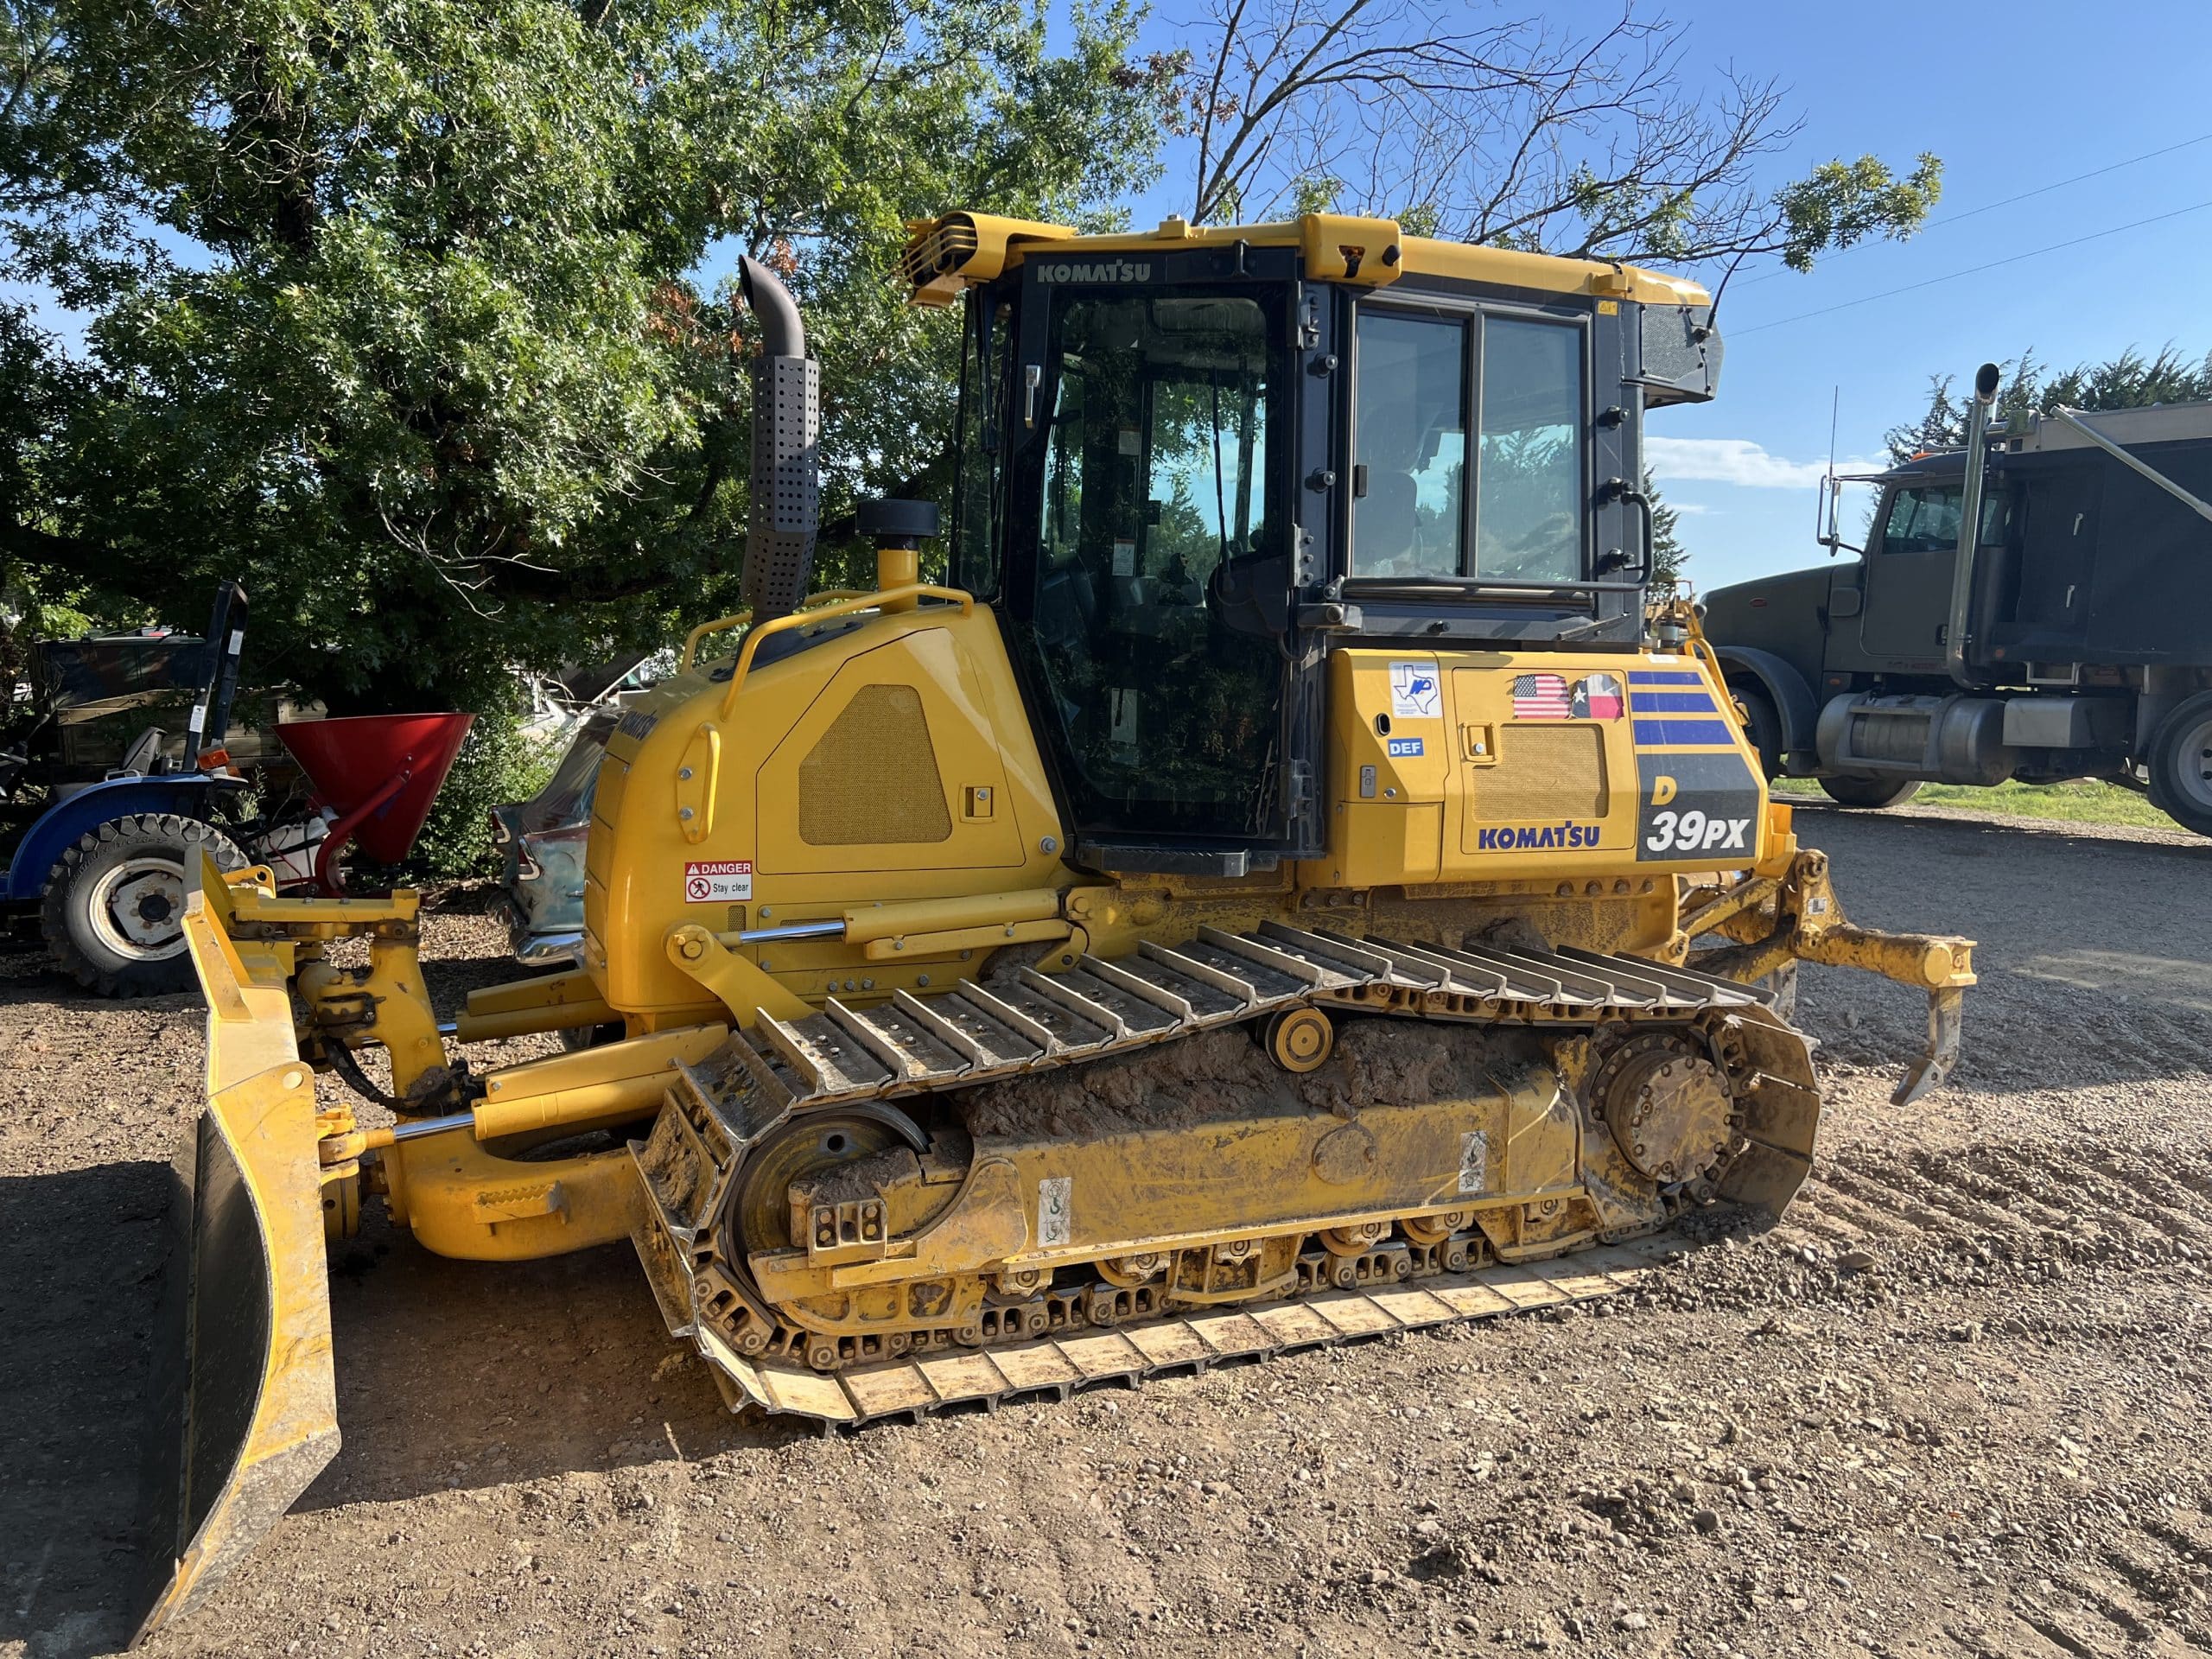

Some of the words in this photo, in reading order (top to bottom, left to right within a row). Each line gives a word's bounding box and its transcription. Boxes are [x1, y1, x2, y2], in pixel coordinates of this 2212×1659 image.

[1037, 258, 1151, 283] KOMATSU
[1389, 742, 1421, 754] DEF
[1651, 776, 1677, 805] D
[1478, 821, 1599, 849] KOMATSU
[1647, 810, 1751, 851] 39PX
[702, 863, 751, 874] DANGER
[713, 883, 728, 894] Stay
[732, 882, 748, 892] clear
